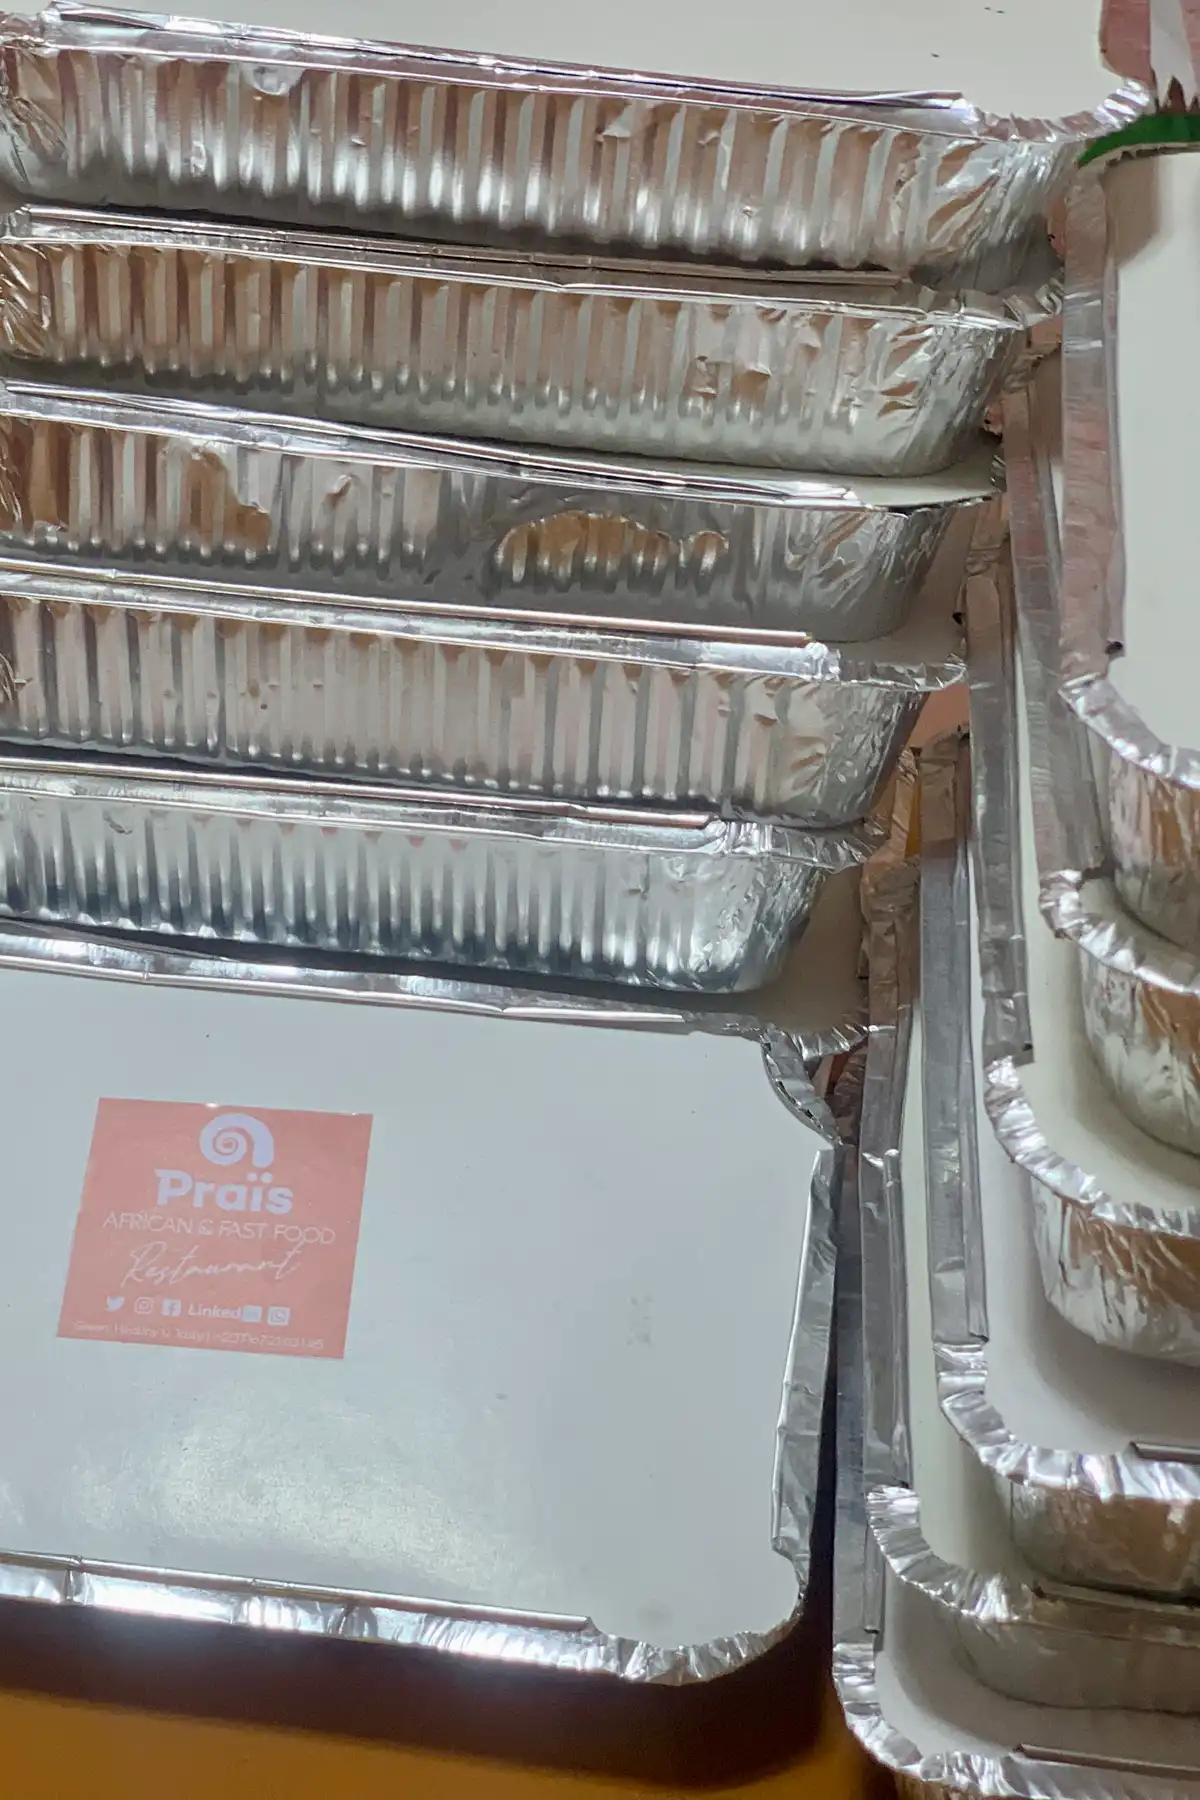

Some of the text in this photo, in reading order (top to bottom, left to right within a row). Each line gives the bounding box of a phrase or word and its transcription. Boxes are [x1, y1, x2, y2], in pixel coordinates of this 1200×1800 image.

[154, 1168, 294, 1215] Praïs
[102, 1210, 336, 1245] AFRICAN & FAST FOOD
[120, 1241, 302, 1288] Restaurant
